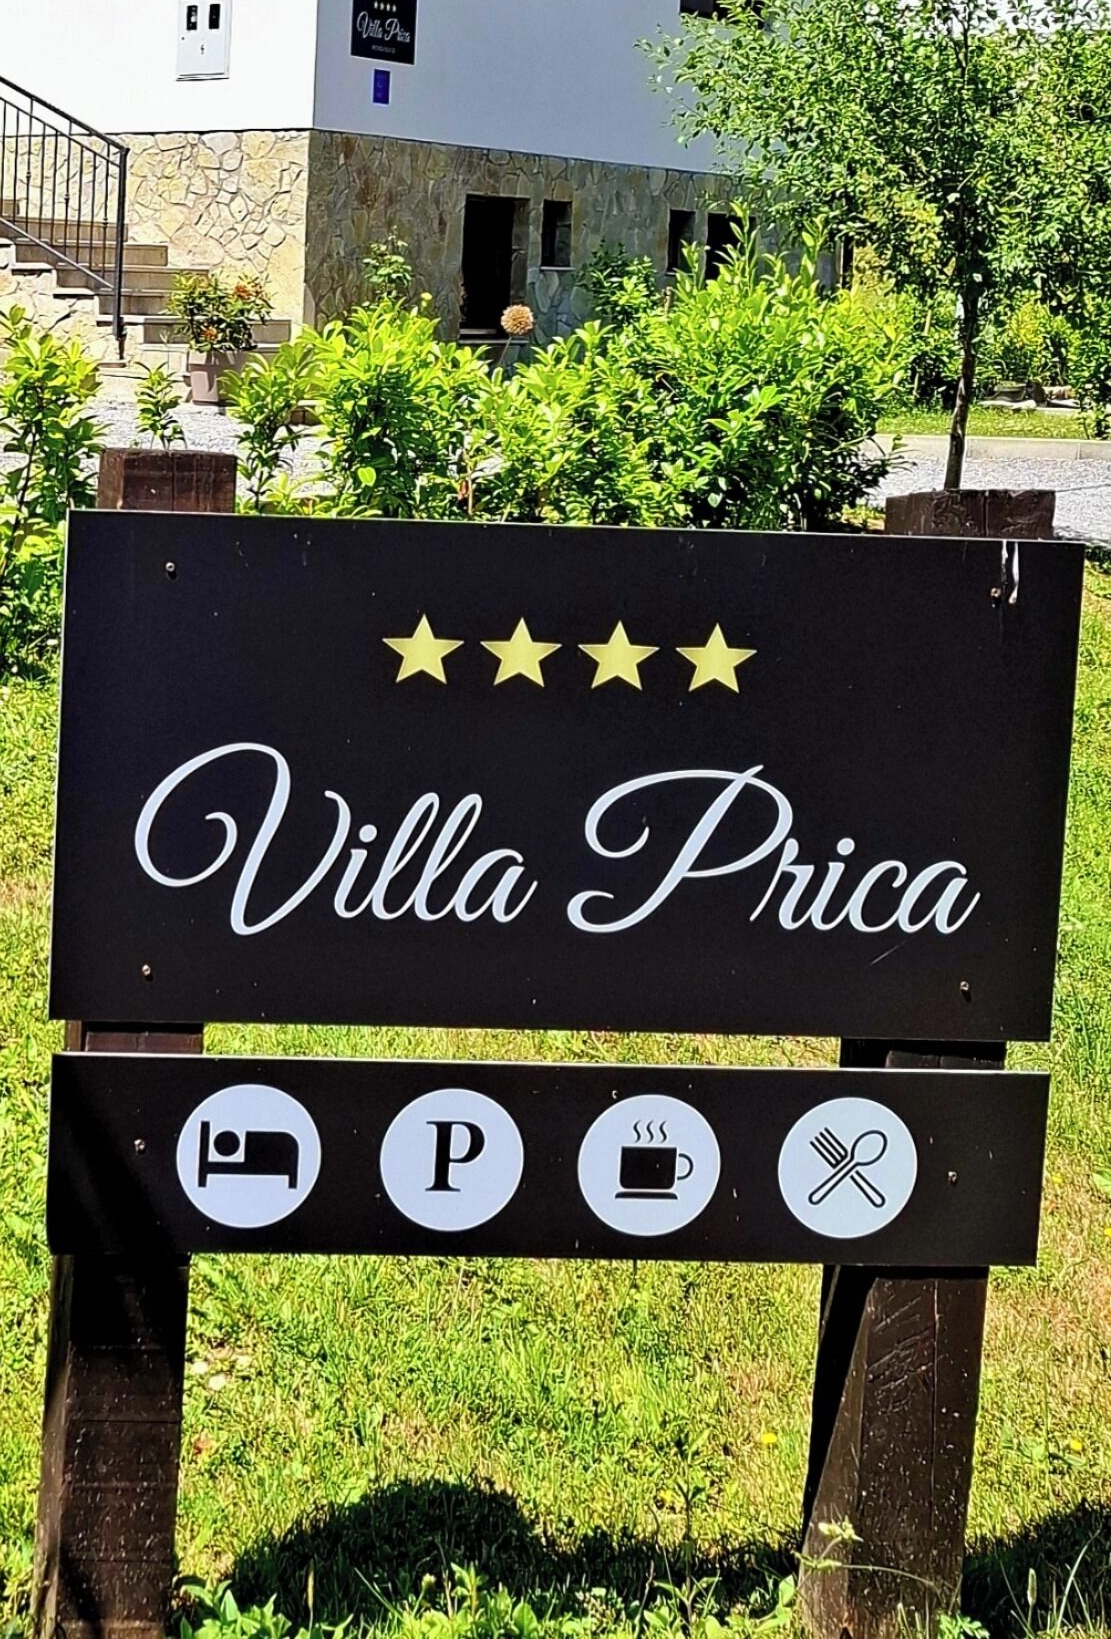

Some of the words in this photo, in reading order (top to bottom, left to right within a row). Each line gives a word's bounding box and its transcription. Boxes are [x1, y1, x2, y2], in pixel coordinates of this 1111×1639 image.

[356, 11, 384, 39] Villa
[134, 742, 537, 935] Villa
[567, 764, 980, 934] Prica
[425, 1121, 485, 1192] P
